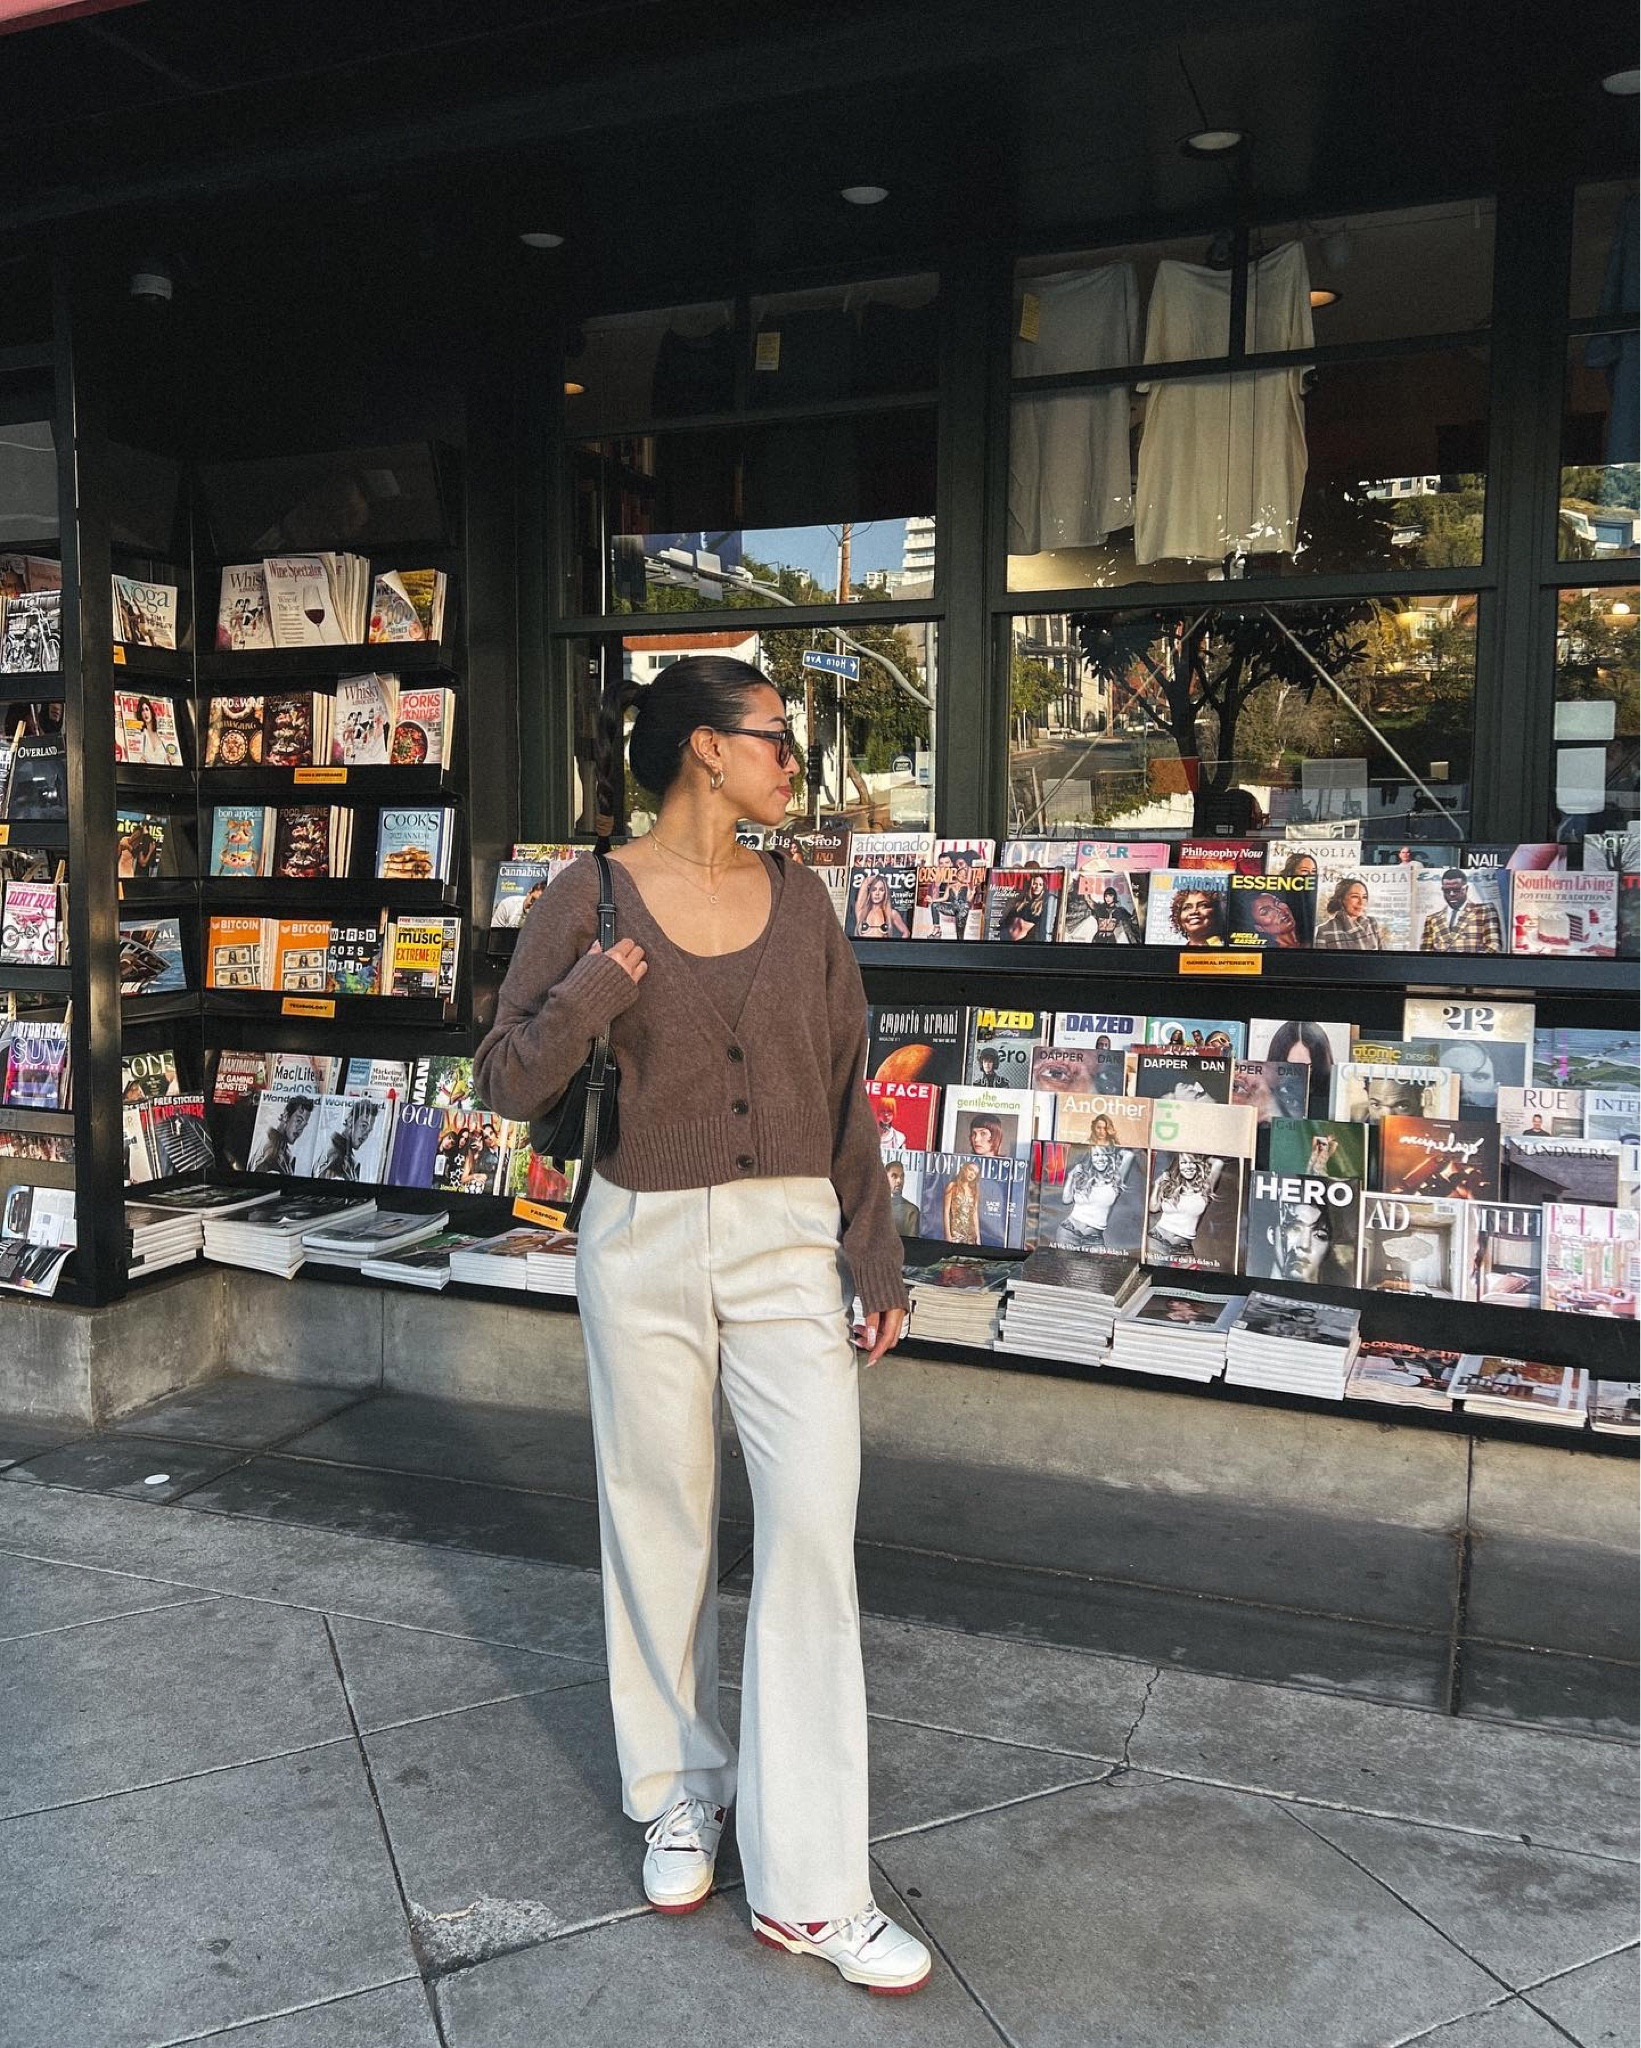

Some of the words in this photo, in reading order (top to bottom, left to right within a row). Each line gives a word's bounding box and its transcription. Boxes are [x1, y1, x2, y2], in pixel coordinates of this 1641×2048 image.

[403, 694, 440, 708] FORKS
[18, 745, 57, 758] OVERLAND
[218, 809, 232, 818] bon
[384, 813, 439, 831] COOK'S
[856, 835, 930, 853] aficionado
[1181, 847, 1238, 861] Philosophy
[1240, 849, 1263, 858] Now
[1467, 853, 1504, 867] NAIL
[1231, 875, 1317, 891] ESSENCE
[1516, 875, 1574, 890] Southern
[1575, 876, 1614, 894] Living
[7, 891, 36, 907] DIRT
[221, 920, 259, 930] BITCOIN
[329, 928, 376, 942] WIRED
[398, 933, 441, 945] music
[330, 946, 364, 957] GOES
[396, 948, 429, 961] EXTREME
[327, 960, 363, 974] WILD
[880, 1010, 920, 1036] emporio
[923, 1010, 959, 1035] armani
[1066, 1014, 1134, 1035] DAZED
[1443, 1006, 1494, 1031] 212
[11, 1037, 67, 1065] SUV
[1039, 1051, 1084, 1063] DAPPER
[1352, 1046, 1402, 1059] atomic
[1143, 1058, 1188, 1070] DAPPER
[1201, 1060, 1225, 1072] DAN
[226, 1074, 254, 1084] GAMING
[886, 1082, 929, 1098] FACE
[983, 1091, 998, 1101] the
[957, 1098, 1021, 1110] gentlewoman
[1063, 1095, 1146, 1117] AnOther
[1523, 1089, 1568, 1110] RUE
[1255, 1174, 1354, 1207] HERO
[1366, 1200, 1410, 1231] AD
